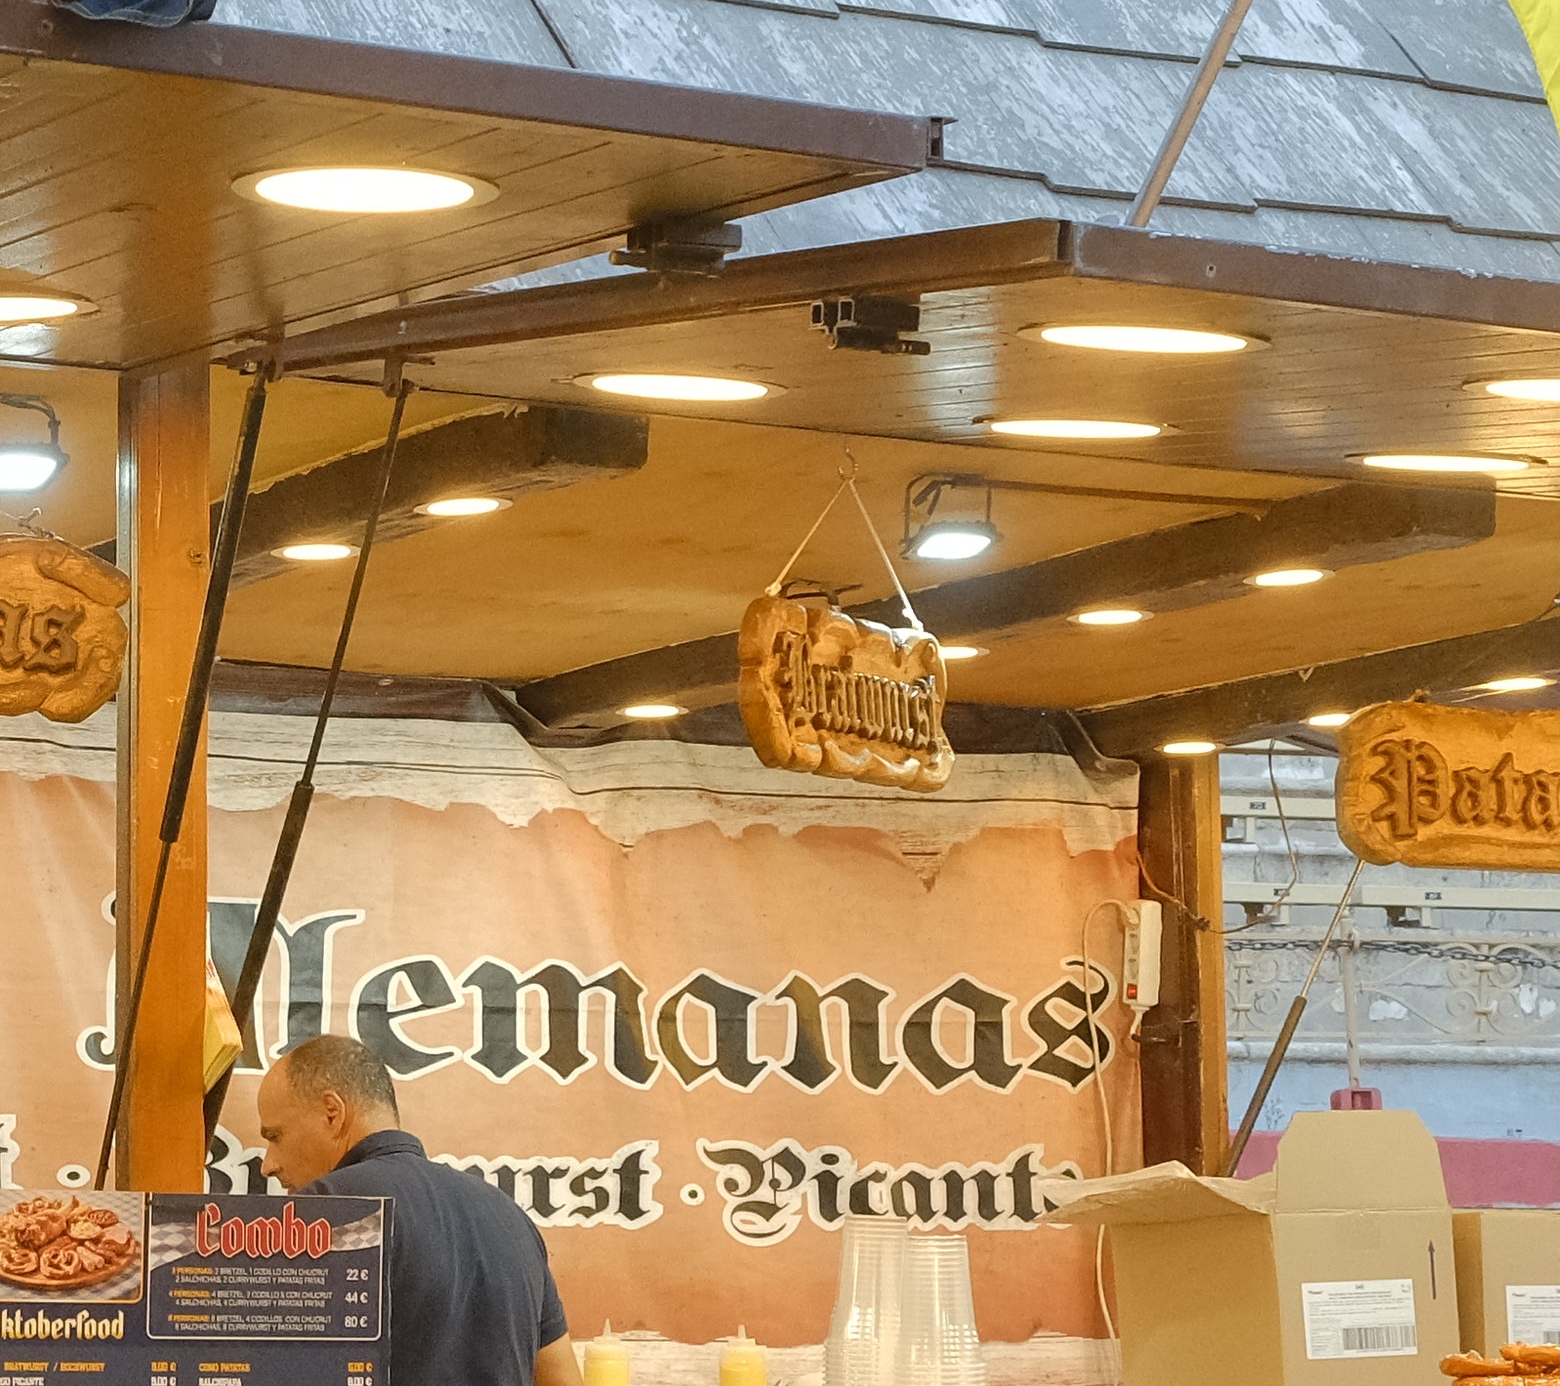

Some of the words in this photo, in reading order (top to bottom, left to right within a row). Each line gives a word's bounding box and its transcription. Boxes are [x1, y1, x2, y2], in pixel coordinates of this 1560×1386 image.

[700, 1142, 1079, 1243] Picant
[195, 1200, 332, 1260] Combo
[345, 1268, 359, 1281] 22
[360, 1268, 369, 1281] €
[344, 1291, 358, 1304] 44
[359, 1292, 369, 1304] €
[344, 1315, 358, 1328] 80
[359, 1316, 368, 1328] €
